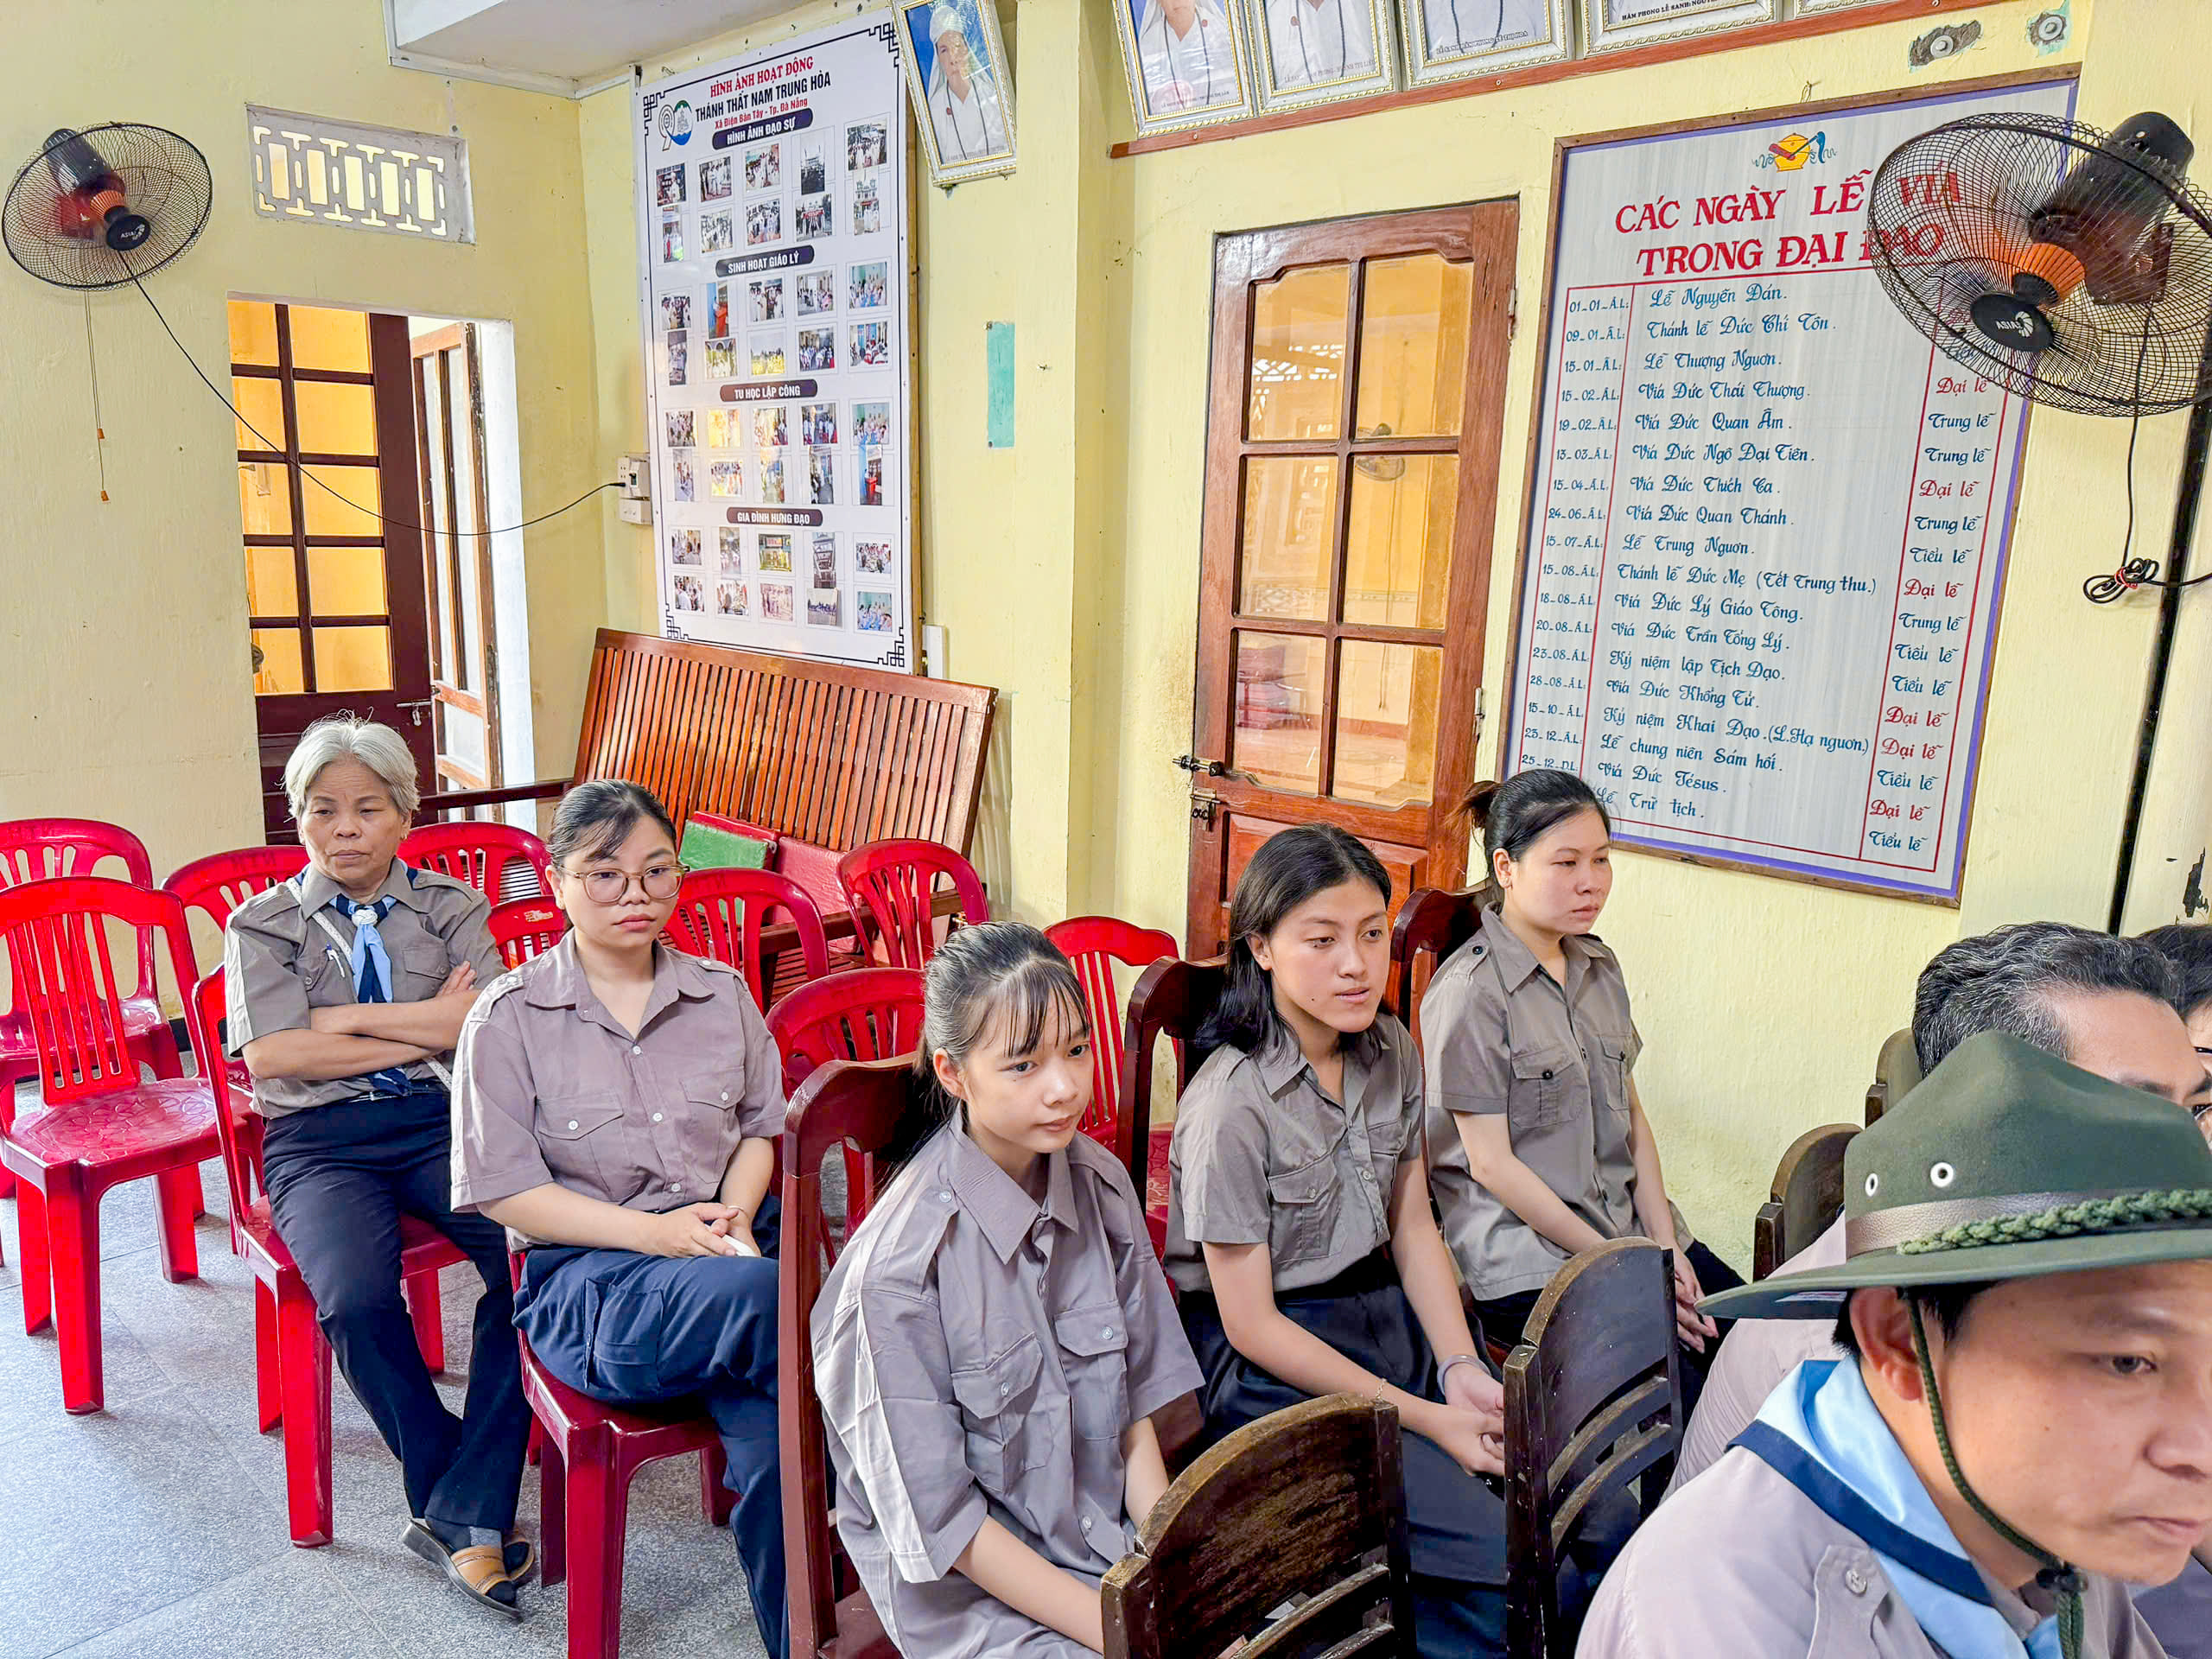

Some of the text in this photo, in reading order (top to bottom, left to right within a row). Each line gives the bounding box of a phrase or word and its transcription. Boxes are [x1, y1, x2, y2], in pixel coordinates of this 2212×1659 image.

[710, 56, 814, 98] HÌNH ẢNH HOẠT ĐỘNG
[695, 70, 831, 122] THÁNH THẤT NAM TRUNG HÒA
[727, 130, 746, 145] HÌNH
[747, 125, 764, 140] ẢNH
[766, 122, 782, 137] ĐẠO
[1615, 194, 1681, 234] CÁC
[1692, 184, 1787, 227] NGÀY
[1809, 168, 1874, 216] LỄ
[728, 251, 799, 274] SINH HOẠT GIÁO LÝ
[1636, 238, 1764, 277] TRONG
[1775, 231, 1849, 269] ĐẠI
[734, 385, 801, 401] TU HỌC LẬP CÔNG
[1935, 376, 1967, 397] Đại
[1928, 412, 1997, 433] Trung lễ
[1923, 447, 1992, 467] Trung lễ
[1918, 479, 1980, 499] Đại lễ
[737, 512, 750, 523] GIA
[751, 511, 770, 524] ĐÌNH
[793, 512, 810, 526] ĐẠO
[1914, 514, 1984, 537] Trung lễ
[1909, 546, 1974, 564] Tiểu lễ
[1903, 578, 1964, 601] Đại lễ
[1897, 612, 1967, 634] Trung lễ
[1894, 643, 1960, 664] Tiểu lễ
[1891, 675, 1953, 696] Tiểu lễ
[1884, 705, 1950, 728] Đại lễ
[1880, 737, 1944, 760] Đại lễ
[1876, 769, 1940, 791] Tiểu lễ
[1868, 798, 1931, 822] Đại lễ
[1868, 830, 1929, 852] Tiểu lễ
